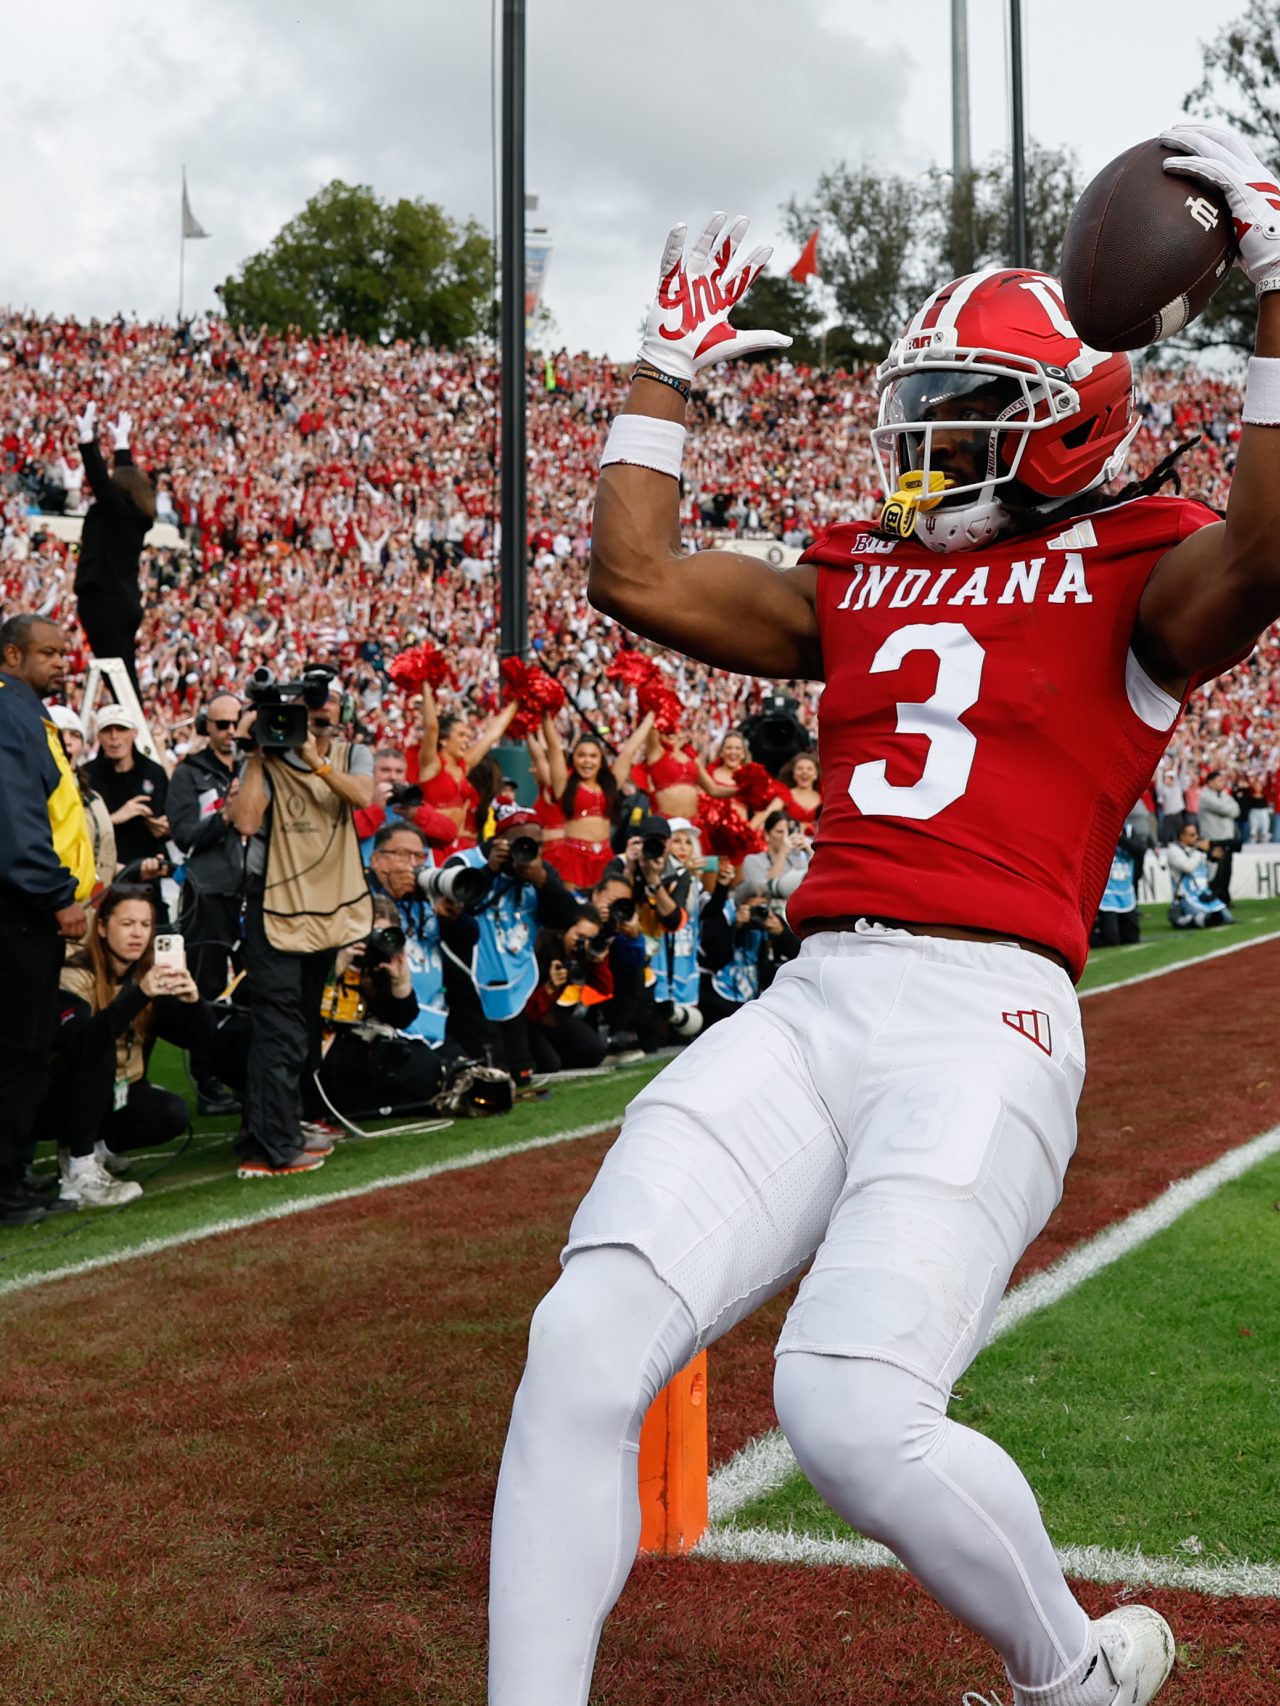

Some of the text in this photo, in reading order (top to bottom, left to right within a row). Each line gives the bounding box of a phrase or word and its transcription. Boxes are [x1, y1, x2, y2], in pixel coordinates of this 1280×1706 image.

[987, 435, 996, 477] INDIANA
[837, 553, 1094, 611] INDIANA
[848, 622, 986, 820] 3
